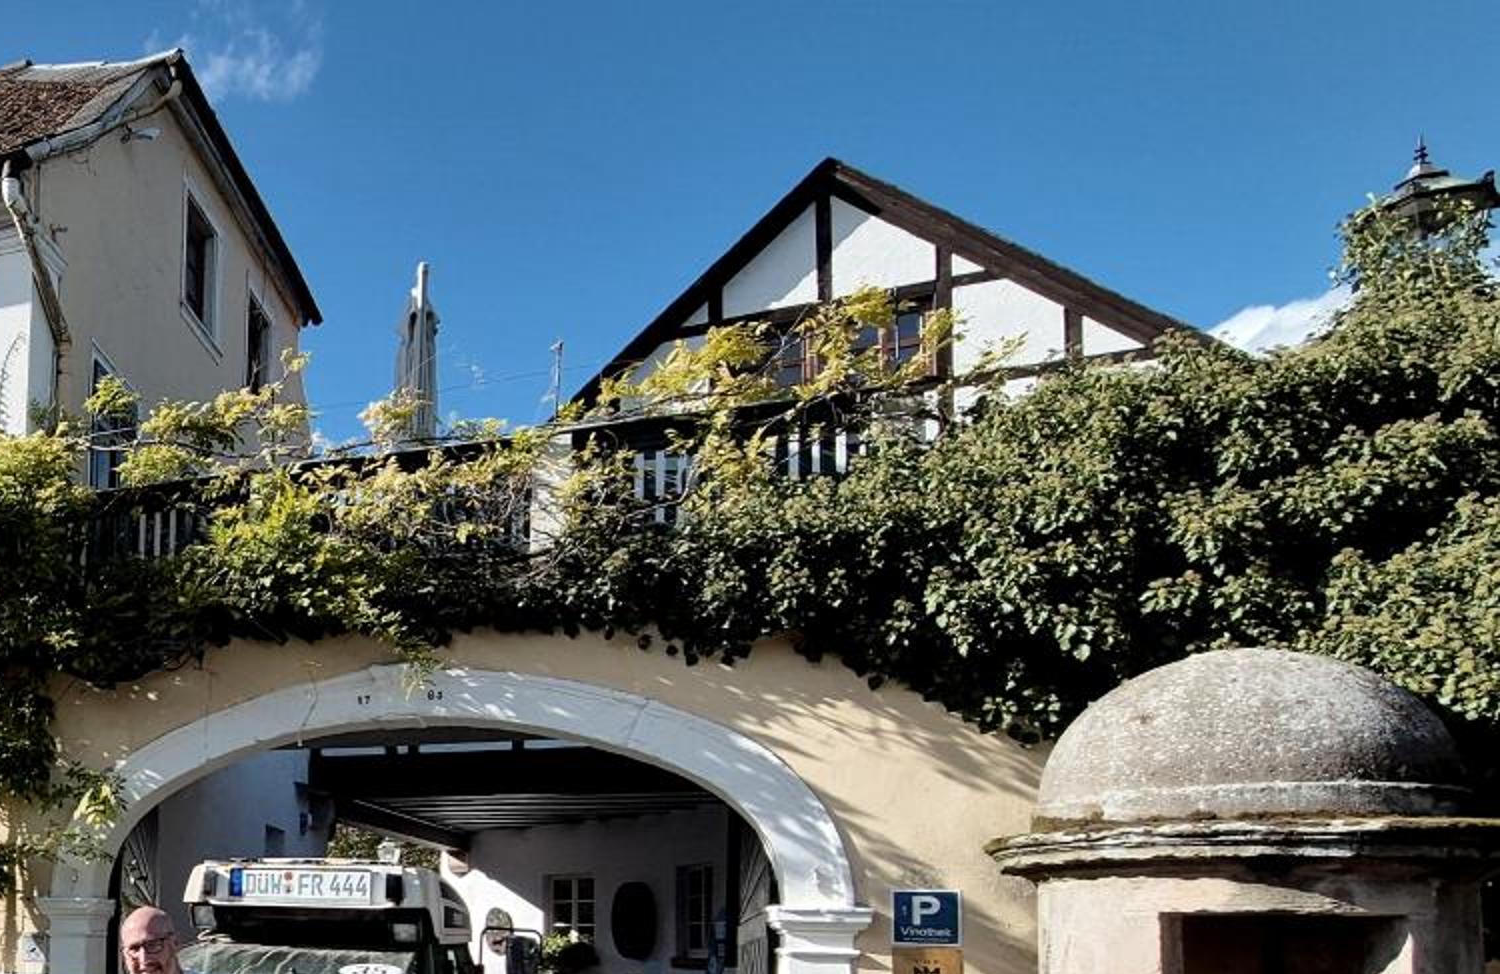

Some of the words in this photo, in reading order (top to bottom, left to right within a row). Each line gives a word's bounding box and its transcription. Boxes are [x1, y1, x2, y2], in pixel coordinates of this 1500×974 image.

[244, 872, 283, 895] DÜW
[298, 873, 323, 896] FR
[330, 873, 368, 897] 444
[911, 895, 941, 926] P
[900, 926, 952, 937] Vinothek
